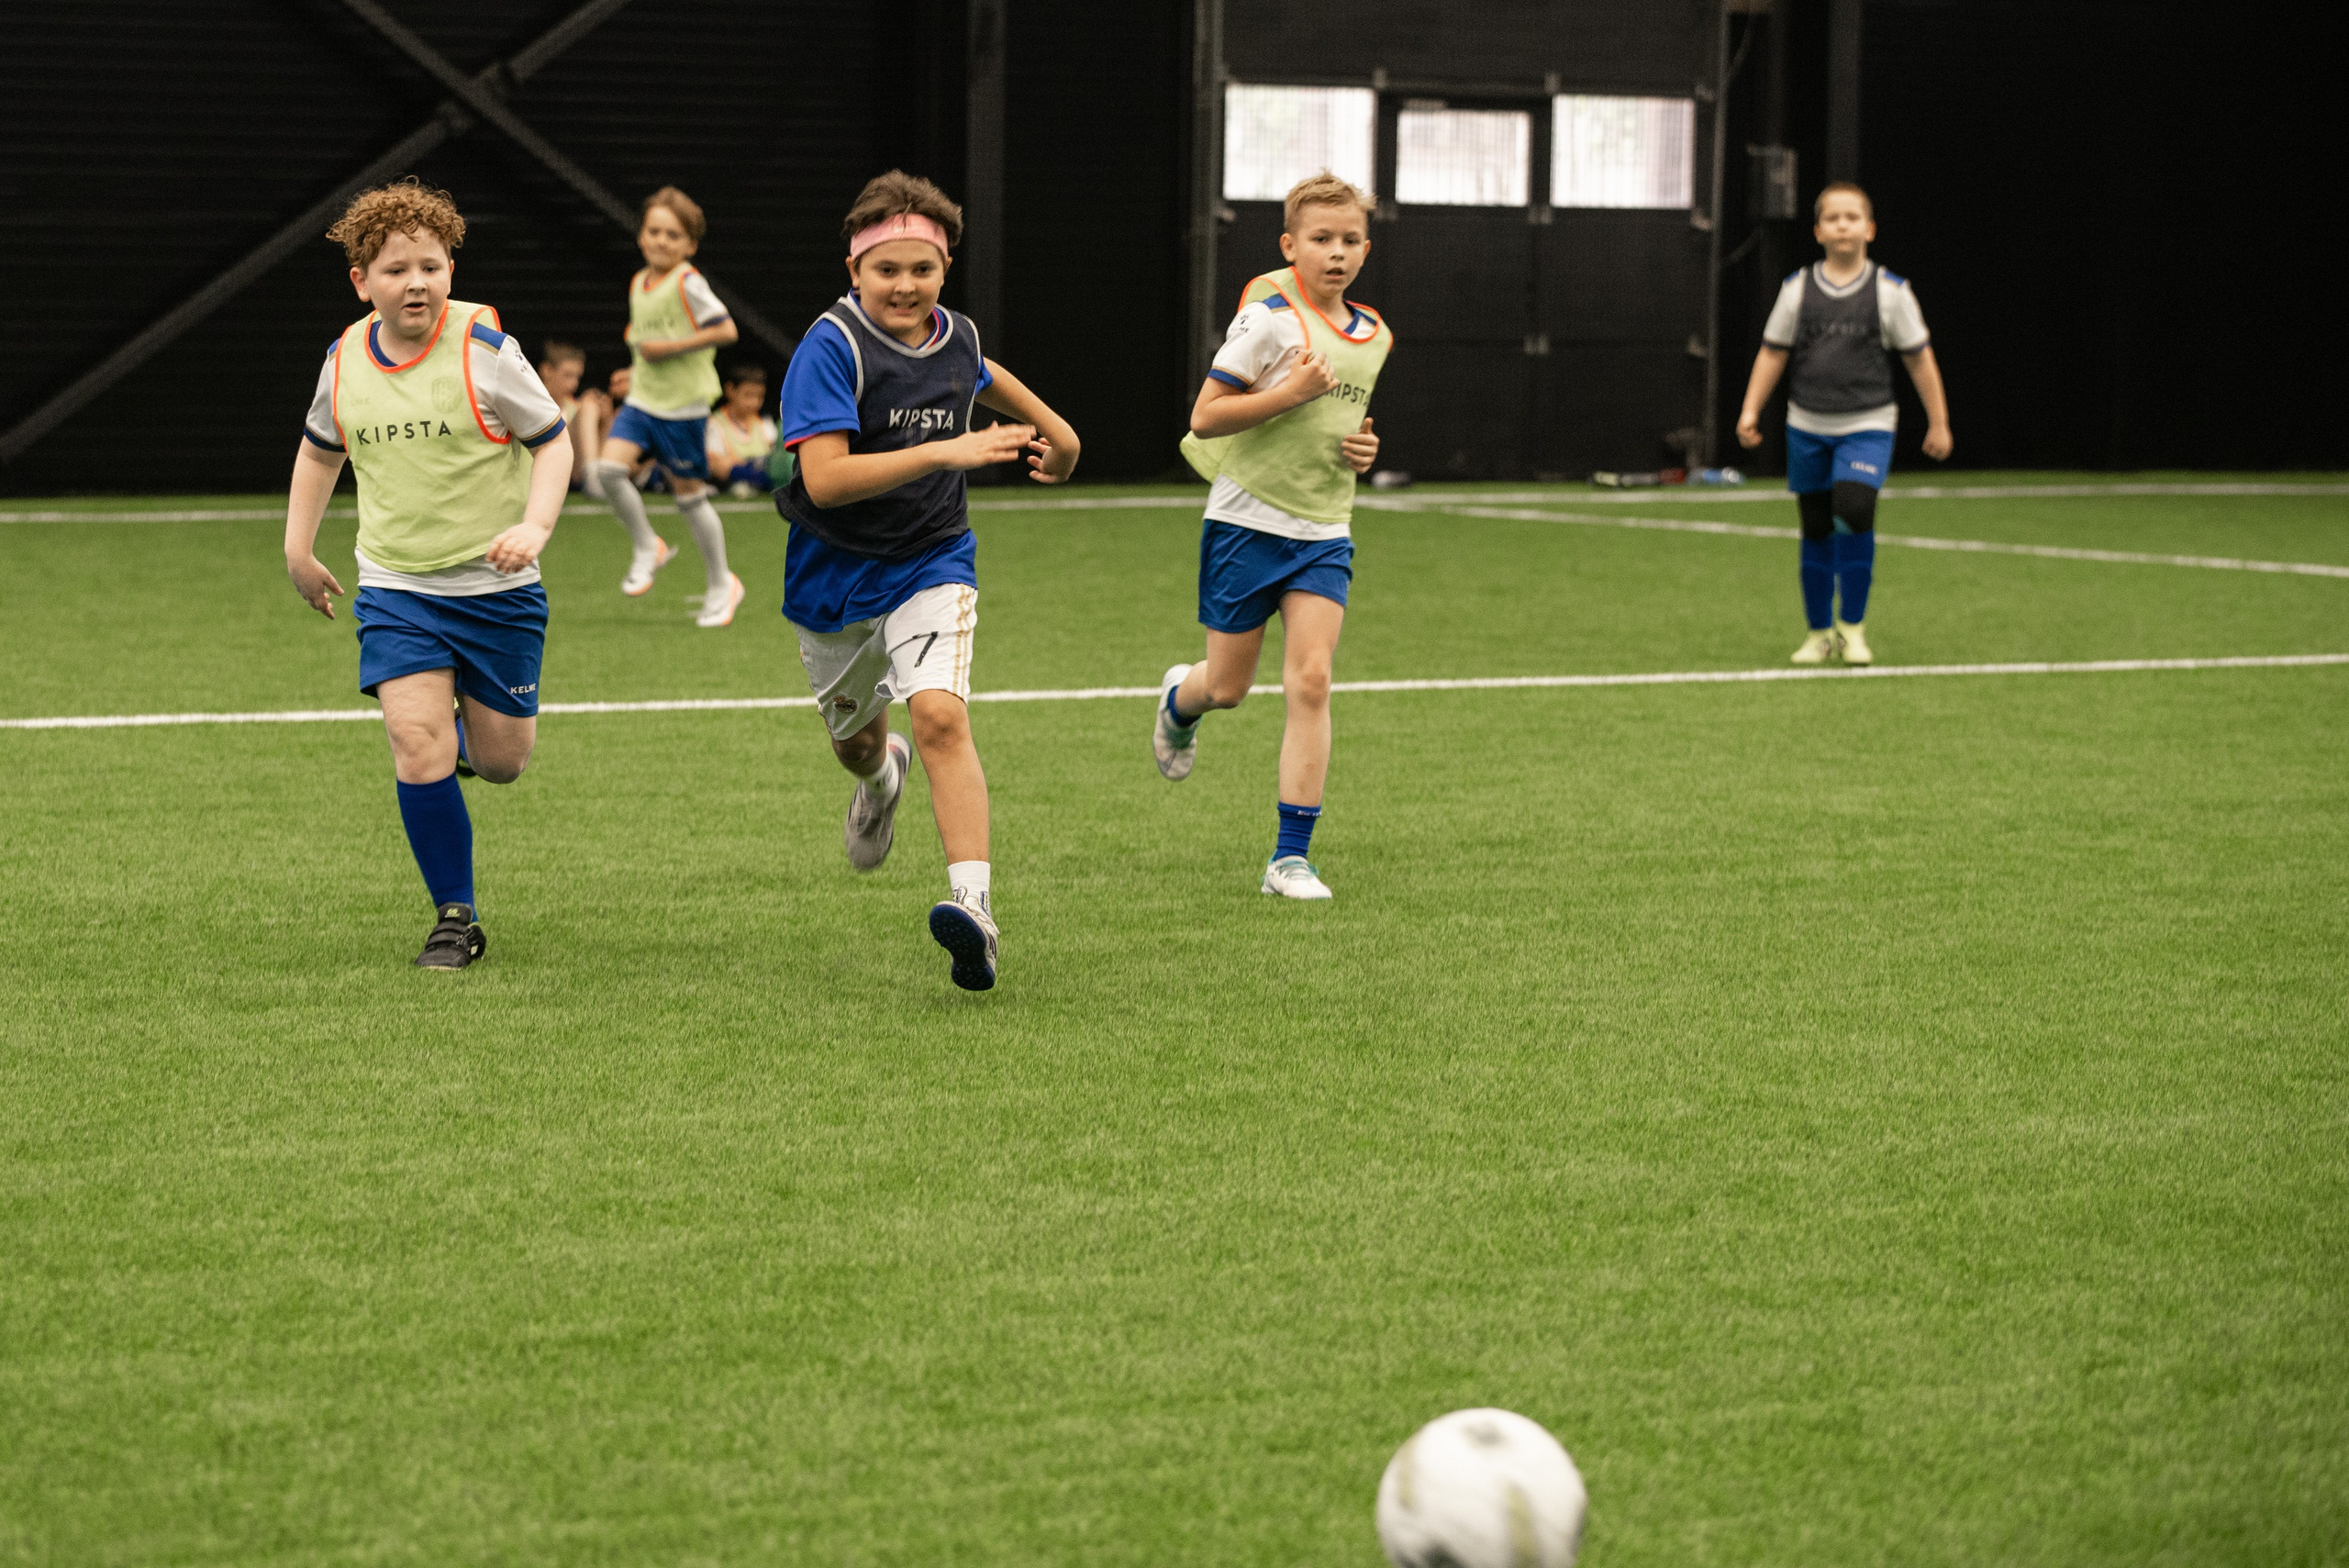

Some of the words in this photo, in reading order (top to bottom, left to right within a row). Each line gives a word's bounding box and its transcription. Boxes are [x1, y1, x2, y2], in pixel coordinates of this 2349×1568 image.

[1325, 382, 1369, 406] IPST
[888, 407, 954, 431] KIPSTA
[356, 419, 451, 446] KIPSTA
[911, 630, 939, 668] 7
